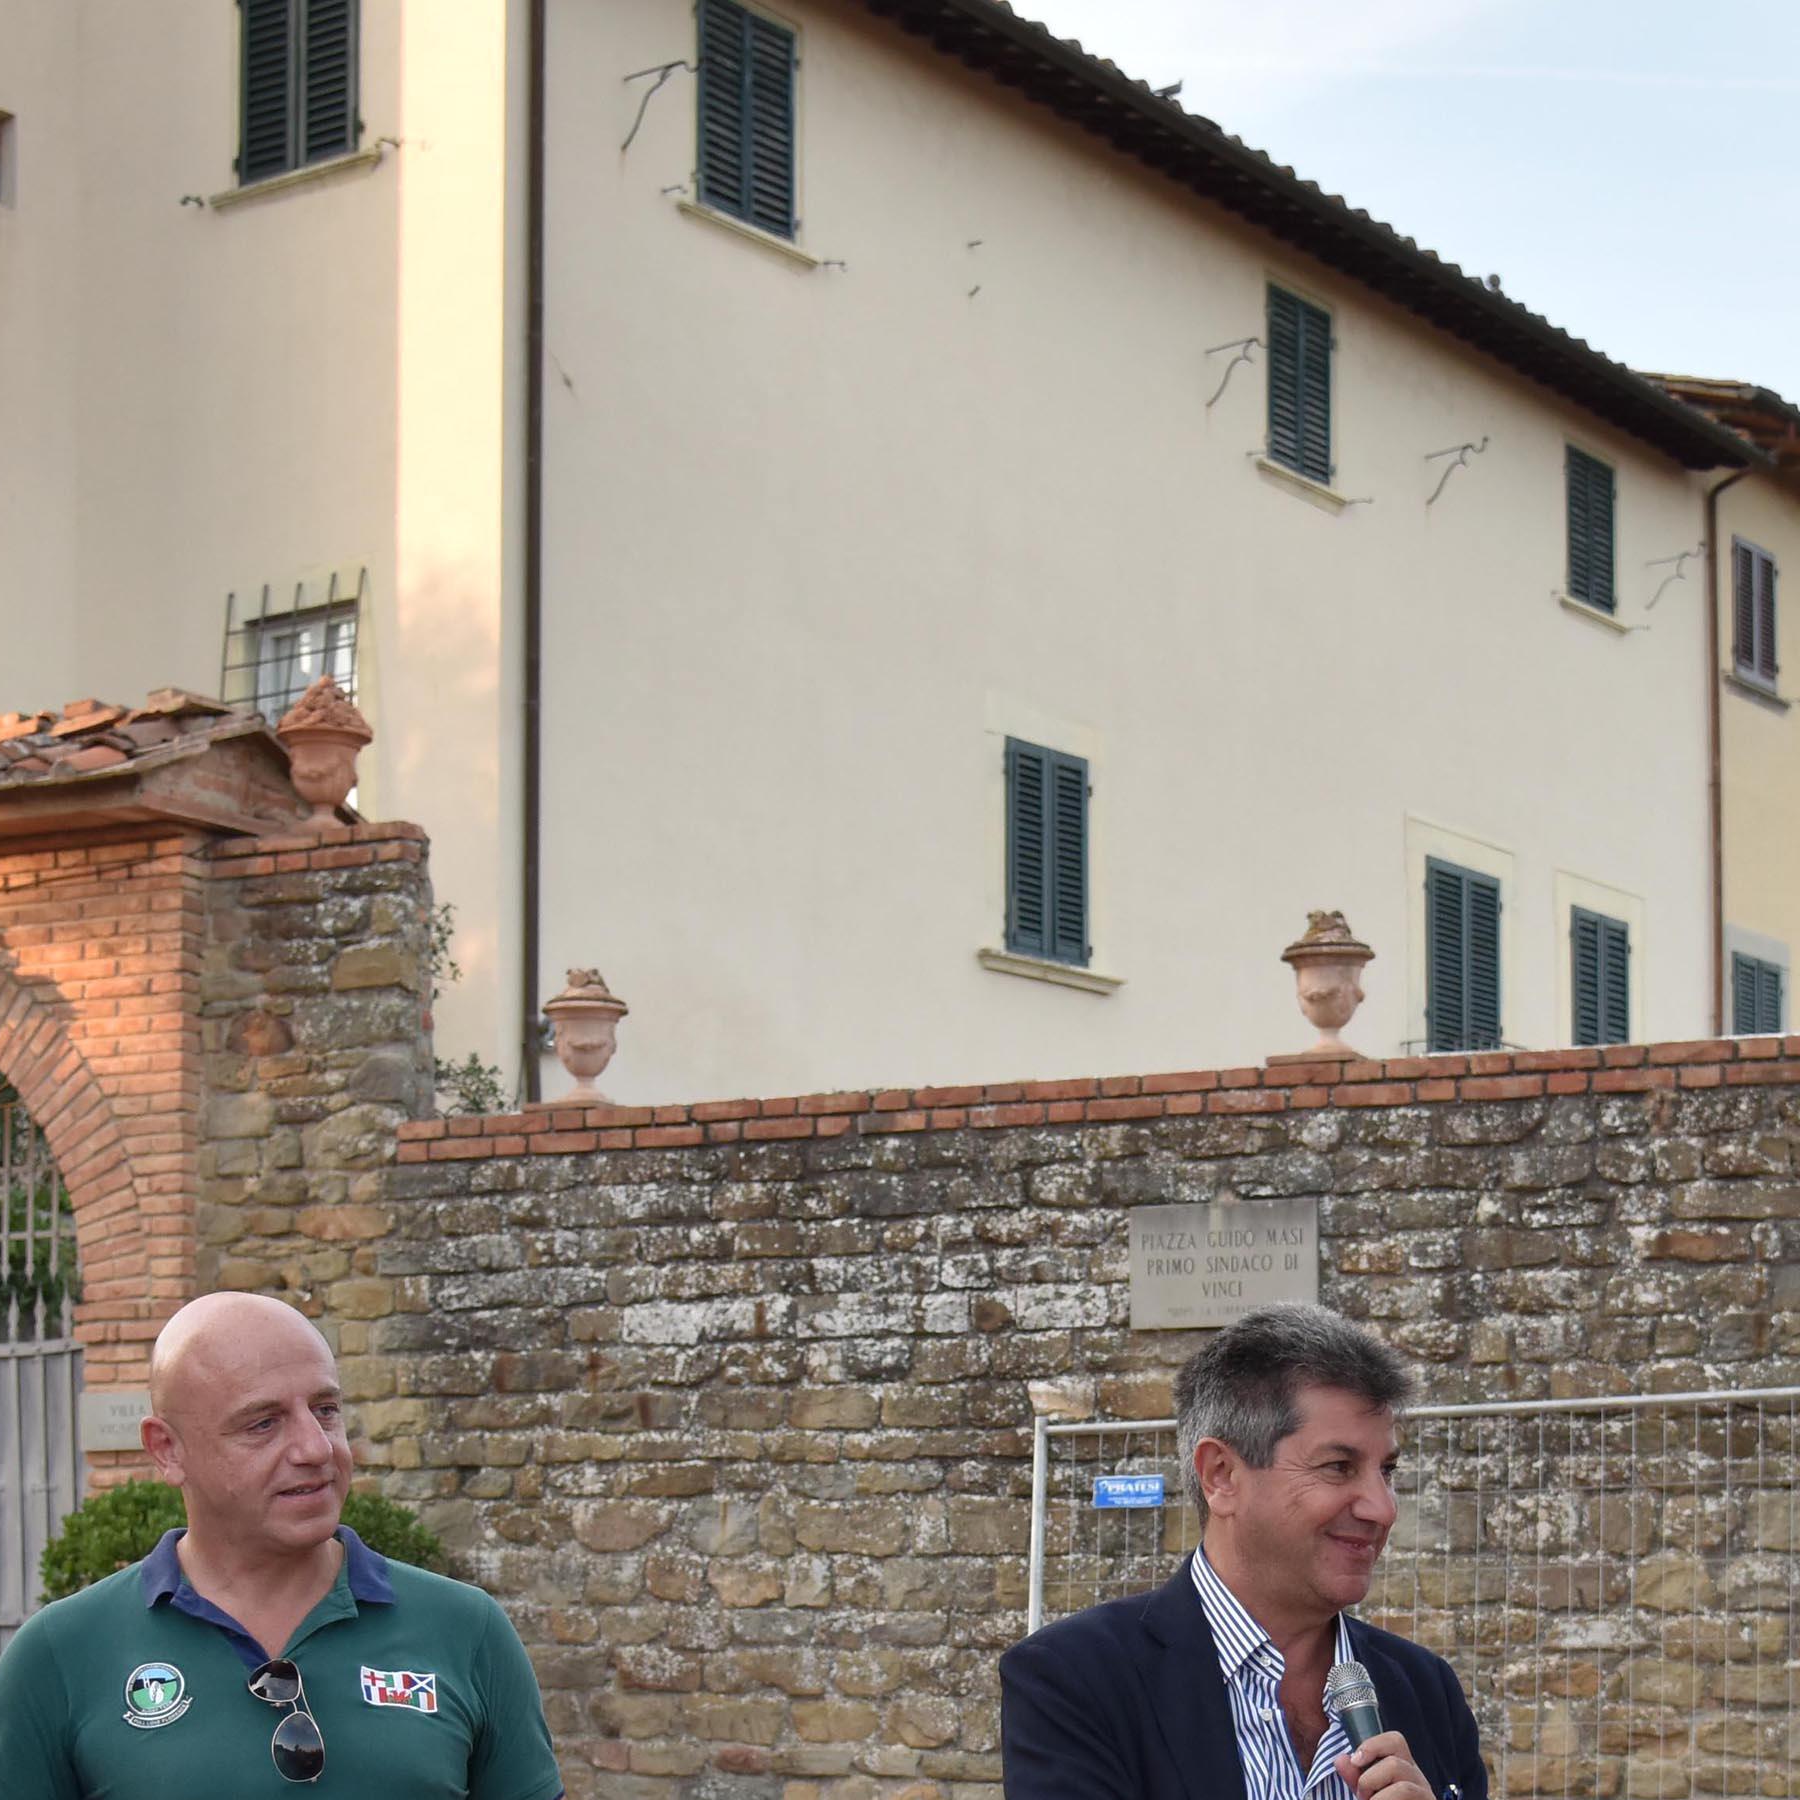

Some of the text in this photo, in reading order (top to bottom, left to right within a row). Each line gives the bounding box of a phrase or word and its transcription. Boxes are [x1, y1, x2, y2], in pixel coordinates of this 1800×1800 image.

[1141, 1227, 1303, 1251] PIAZZA GUIDO MASI
[1146, 1253, 1299, 1276] PRIMO SINDACO DI
[1201, 1280, 1243, 1298] VINCI
